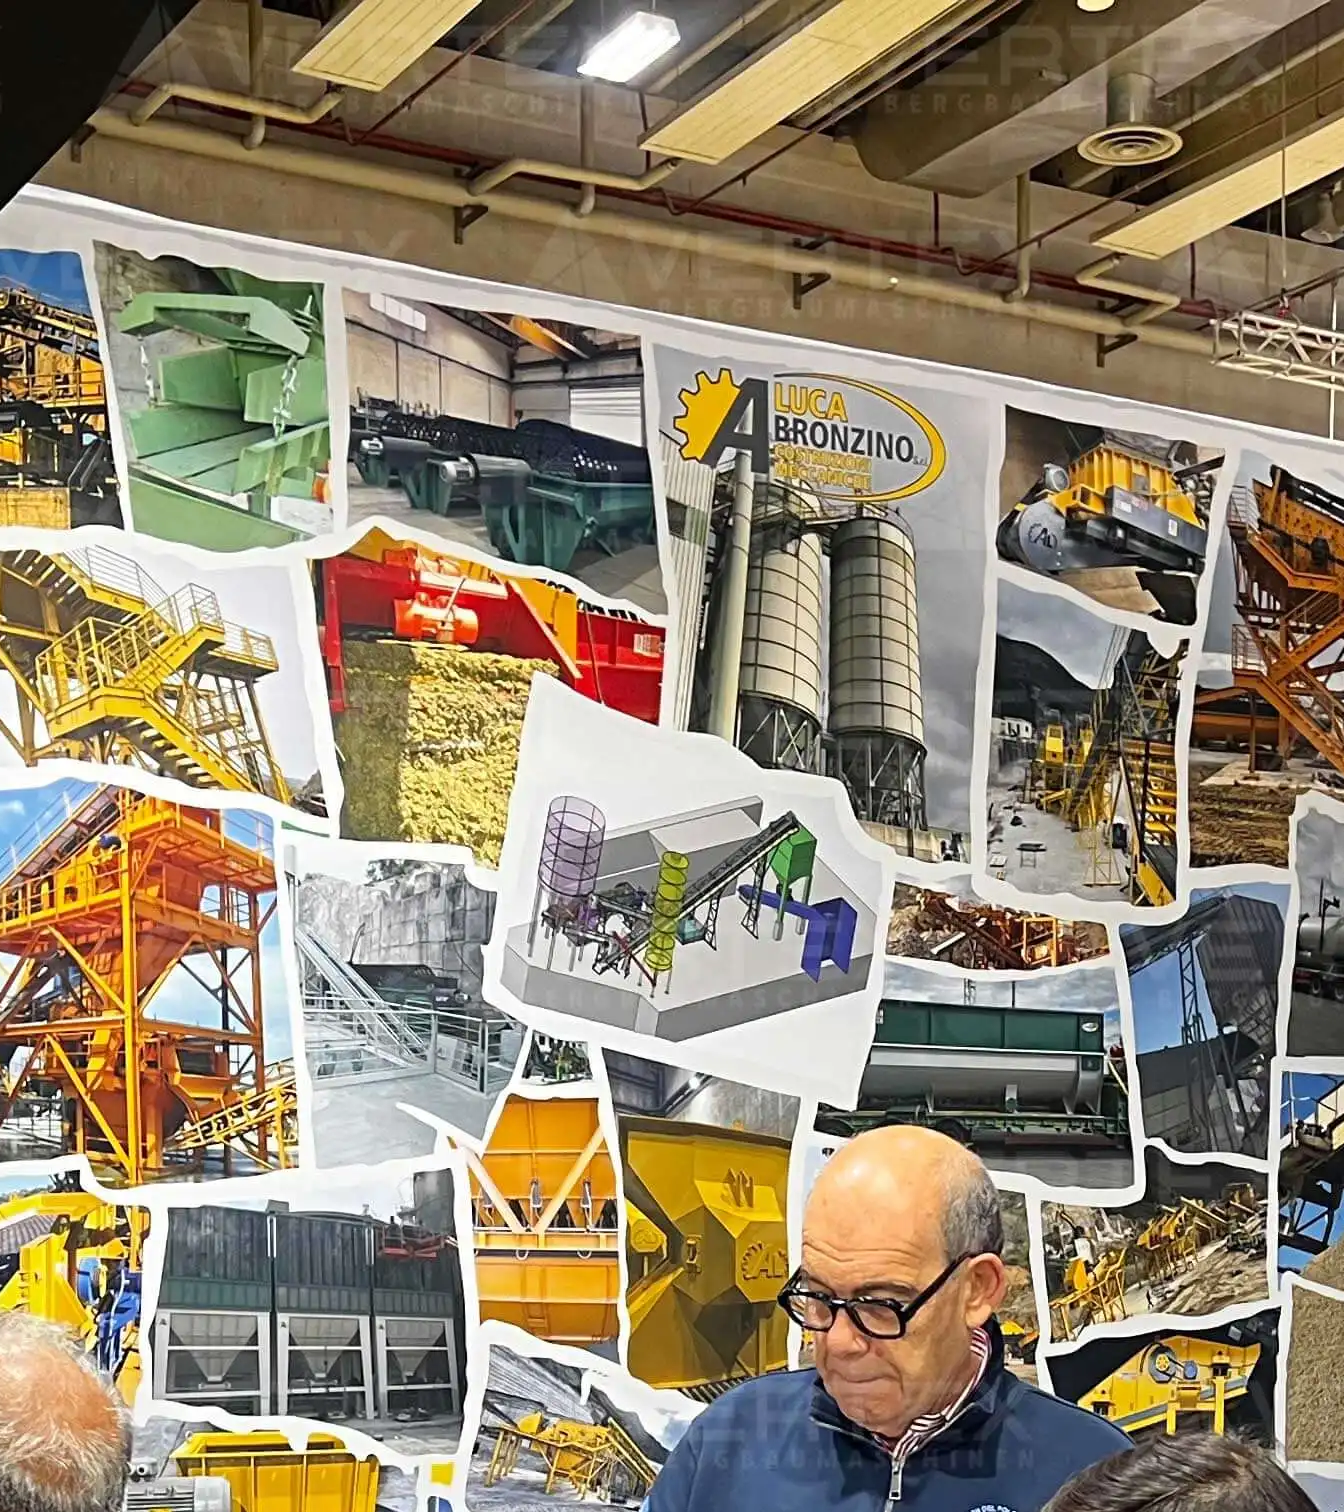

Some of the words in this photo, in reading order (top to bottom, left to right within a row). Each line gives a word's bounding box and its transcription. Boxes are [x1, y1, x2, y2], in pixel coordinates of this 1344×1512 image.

[773, 382, 849, 424] LUCA
[773, 414, 915, 464] BRONZINO
[772, 443, 873, 476] COSTRUZIONI
[772, 461, 874, 492] MECCANICHE
